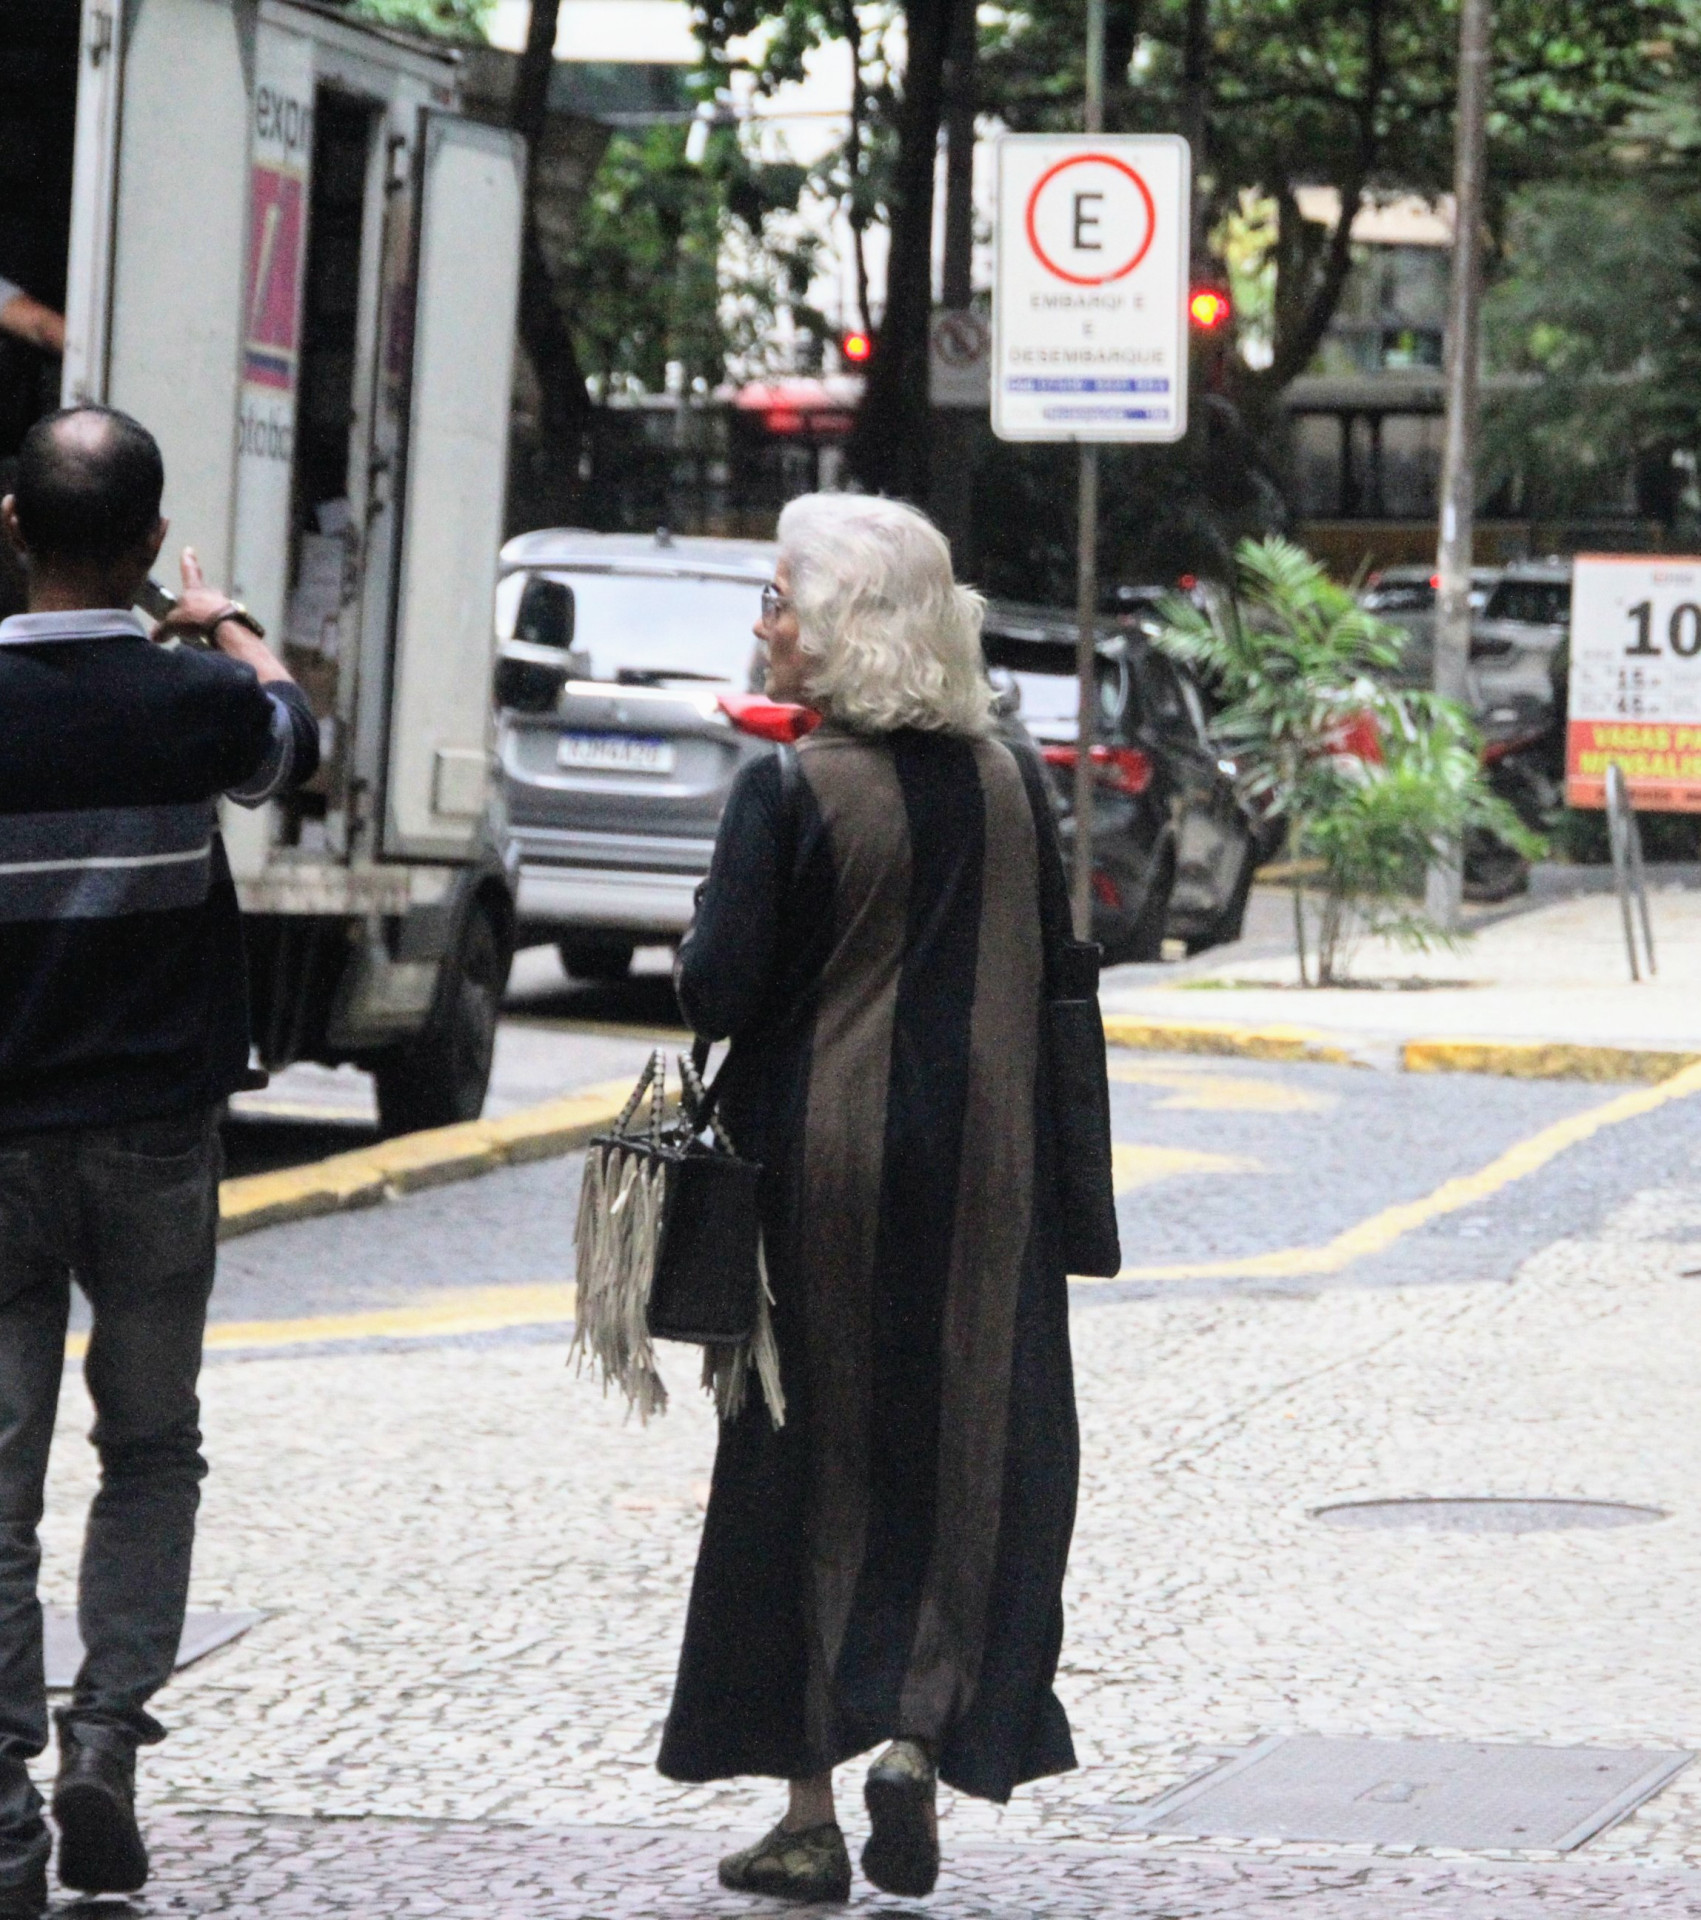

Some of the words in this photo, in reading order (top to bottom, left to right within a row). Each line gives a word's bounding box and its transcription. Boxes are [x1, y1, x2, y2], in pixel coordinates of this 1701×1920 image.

[1072, 191, 1104, 250] E
[1008, 346, 1166, 365] DESEMBARQUE
[1593, 726, 1669, 750] VAGAS
